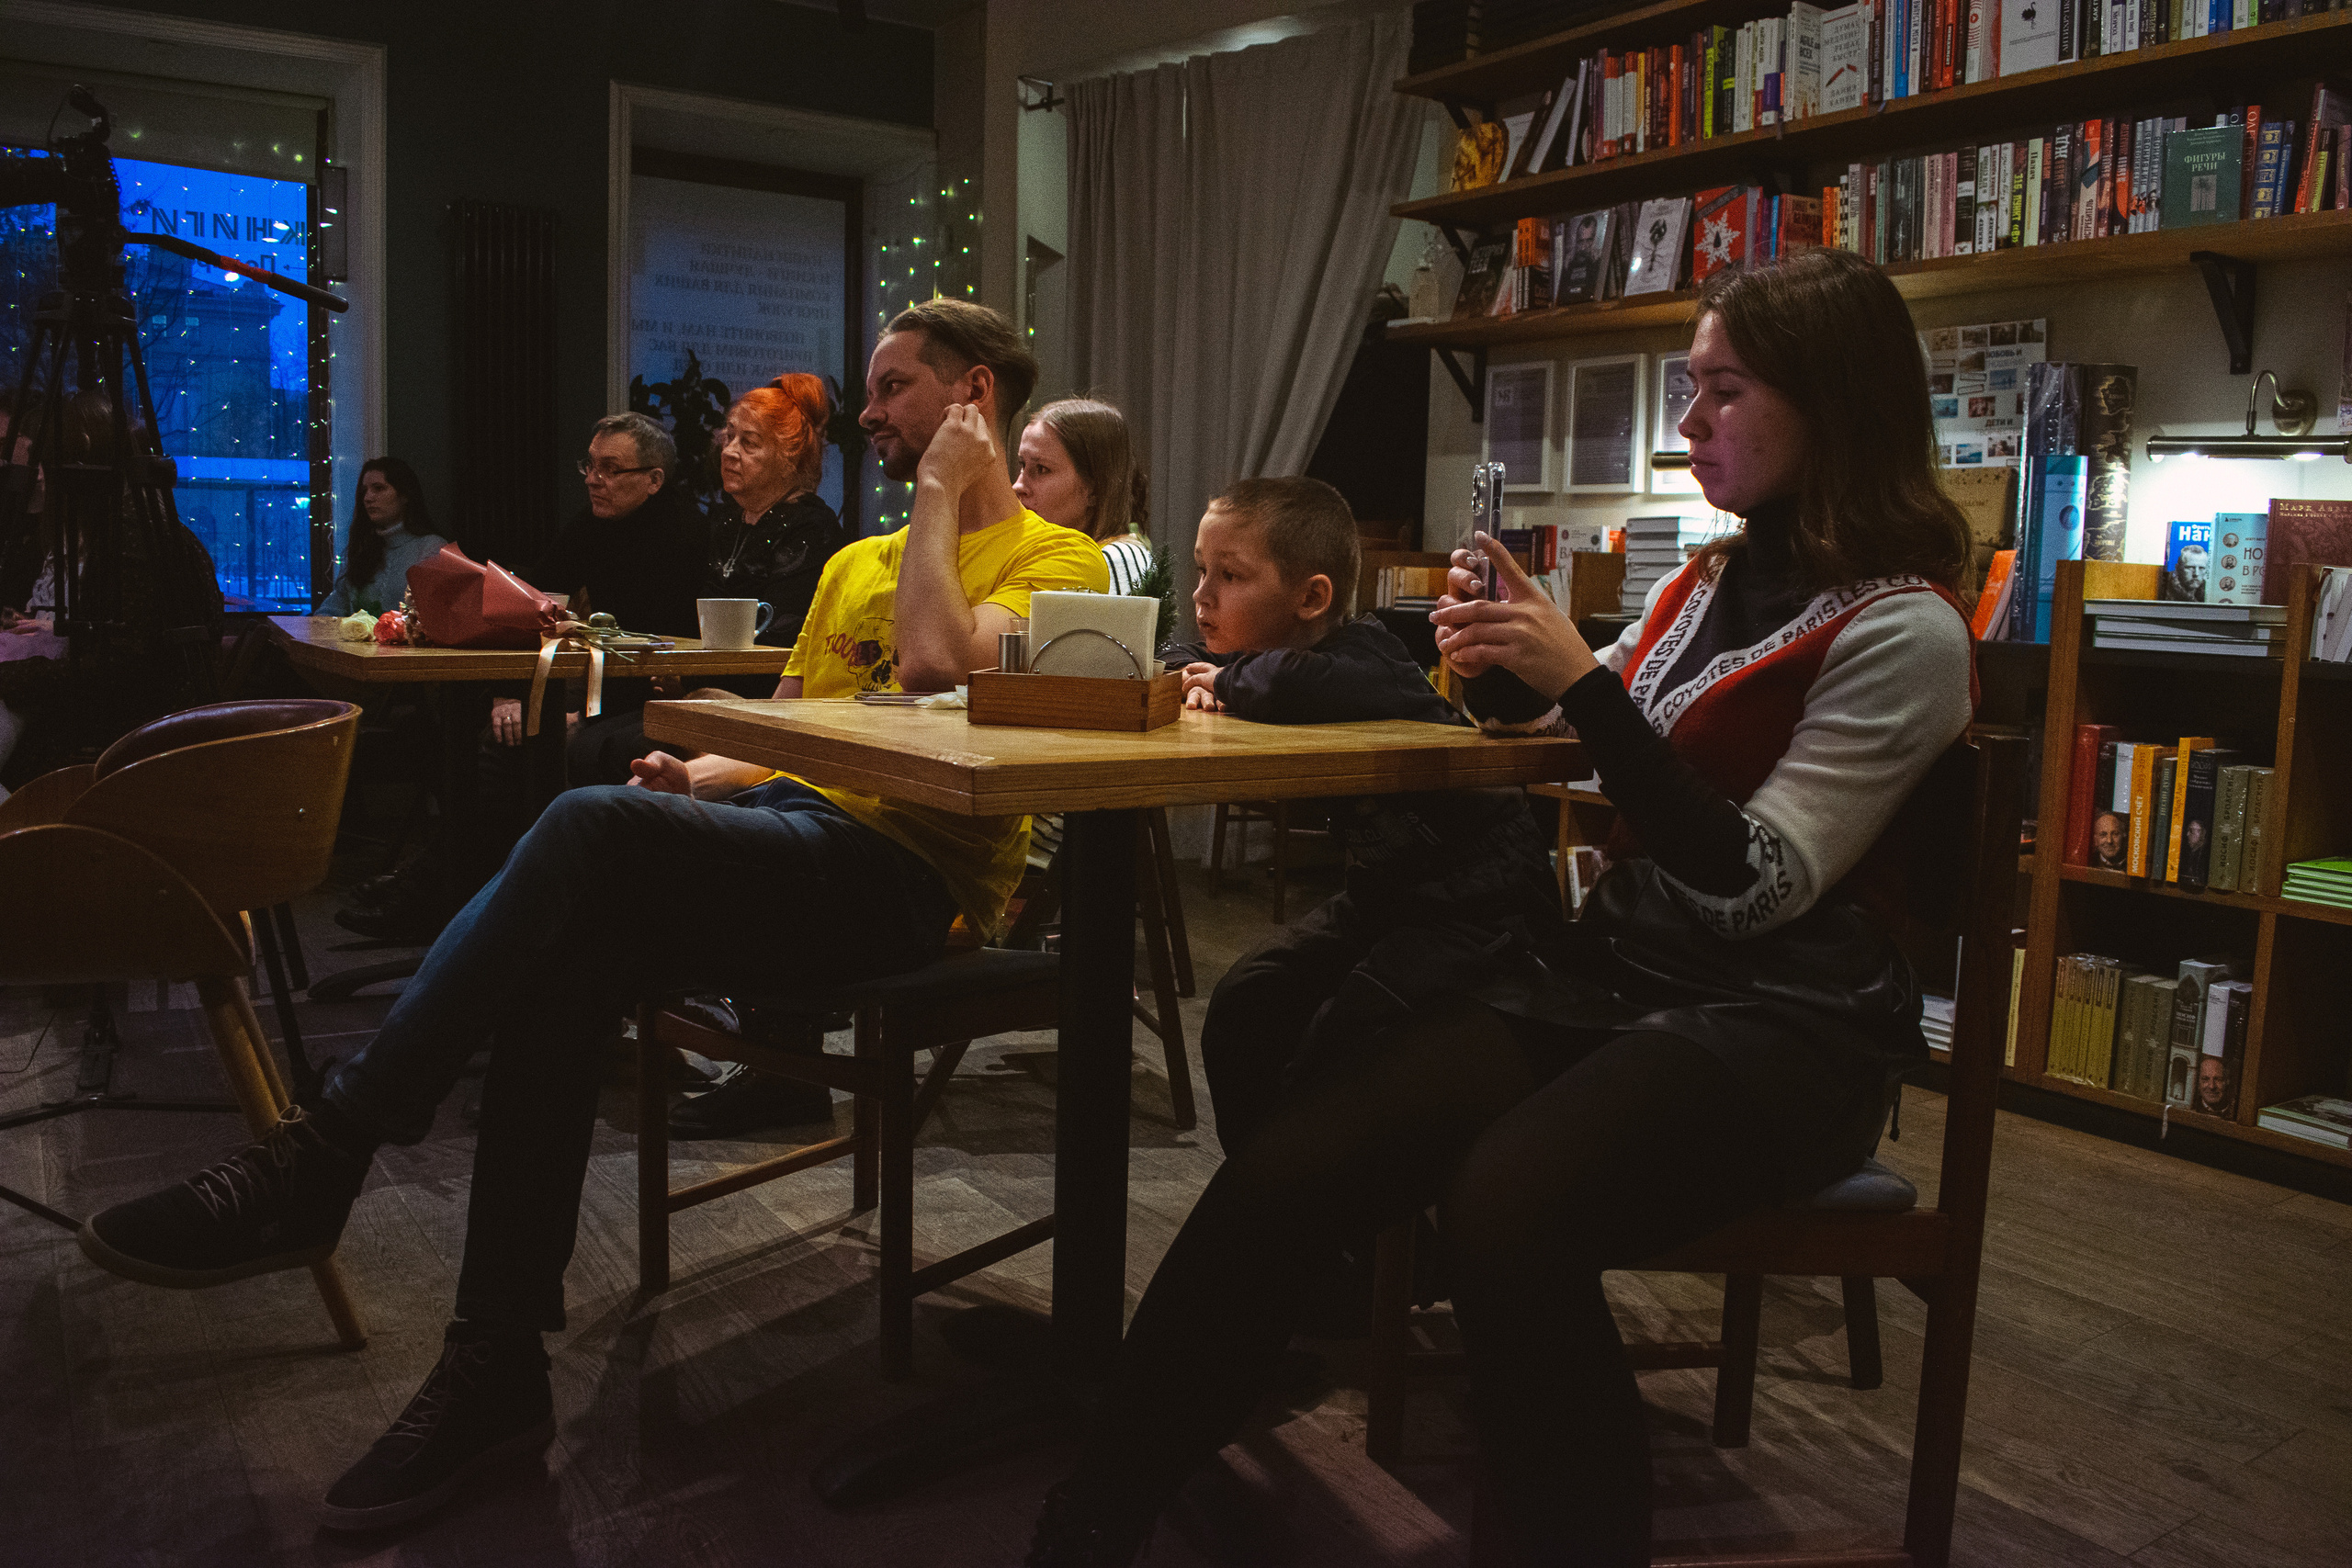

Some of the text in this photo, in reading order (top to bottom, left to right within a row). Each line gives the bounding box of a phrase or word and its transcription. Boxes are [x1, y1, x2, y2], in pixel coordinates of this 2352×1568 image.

[1832, 50, 1860, 62] БЫСТР
[2053, 134, 2071, 160] ЖД
[2184, 152, 2226, 164] ФИГУРЫ
[2191, 163, 2218, 173] РЕЧИ
[1841, 576, 1881, 608] LES
[1662, 655, 1747, 720] COYOTES
[1749, 640, 1777, 661] DE
[1781, 605, 1838, 644] PARIS
[2134, 794, 2144, 816] СЧЁТ
[2131, 817, 2143, 874] МОСКОВСКИЙ
[1702, 905, 1729, 933] DE
[1732, 870, 1793, 934] PARIS
